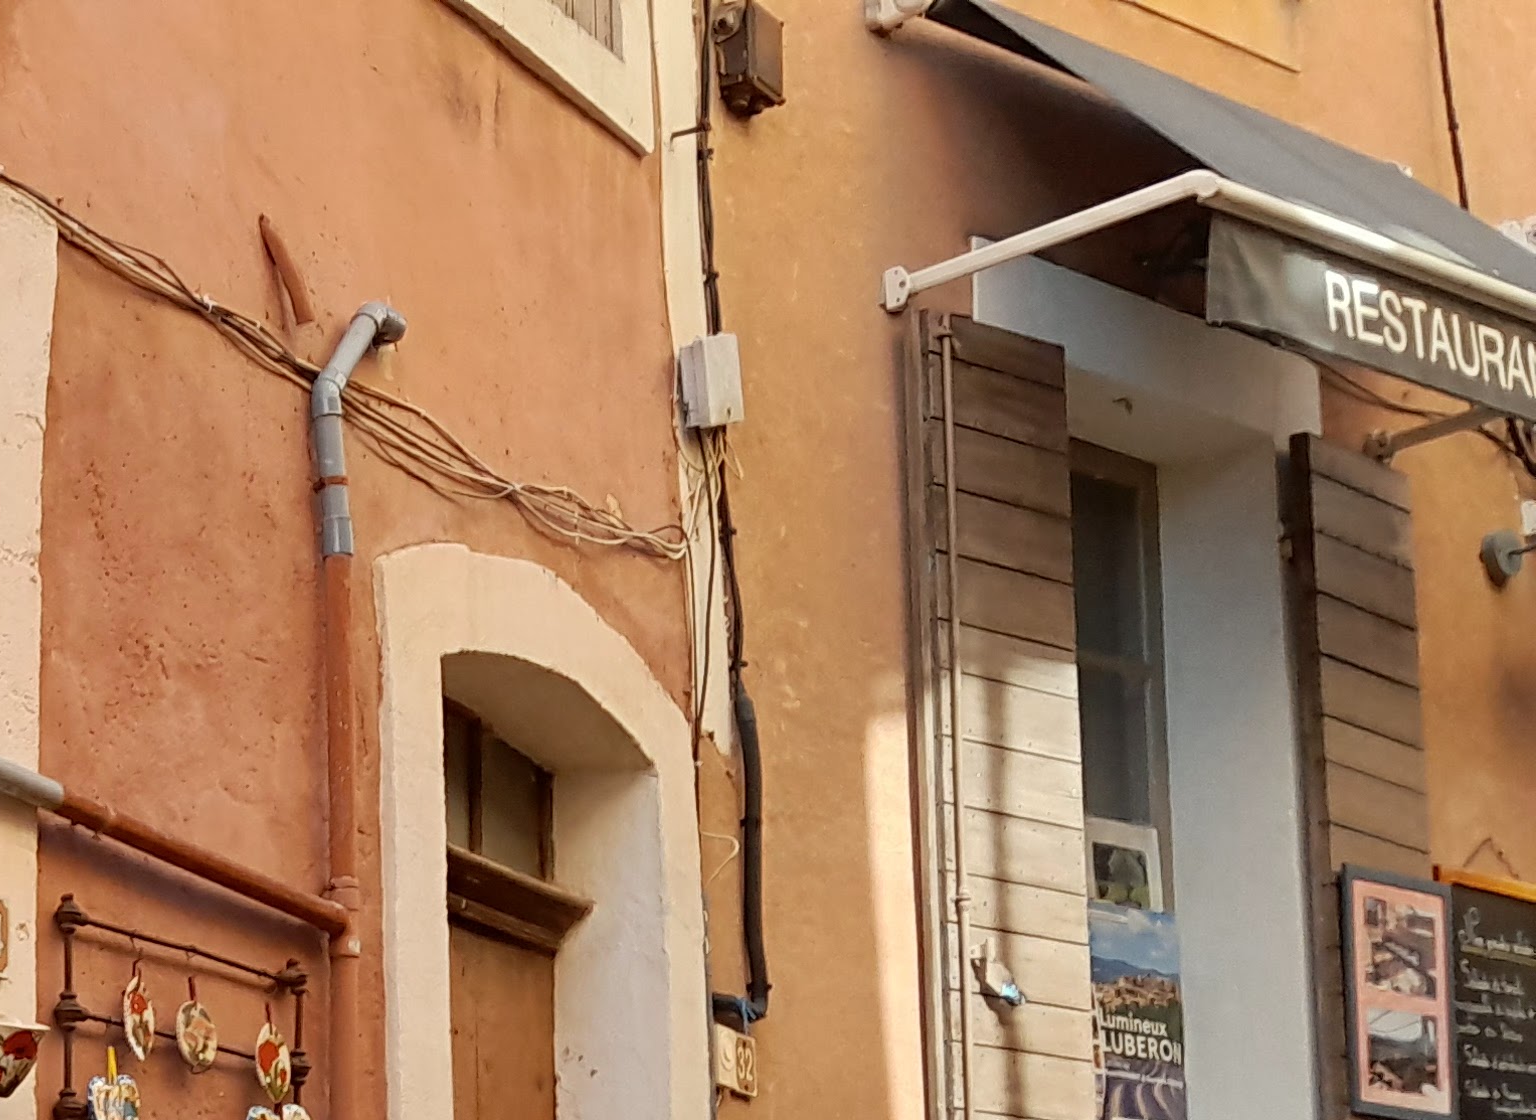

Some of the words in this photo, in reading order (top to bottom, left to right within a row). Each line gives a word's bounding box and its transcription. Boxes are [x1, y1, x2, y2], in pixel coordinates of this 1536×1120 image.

[1098, 1006, 1168, 1037] Lumineux
[737, 1046, 753, 1081] 32
[1100, 1028, 1182, 1066] LUBERON
